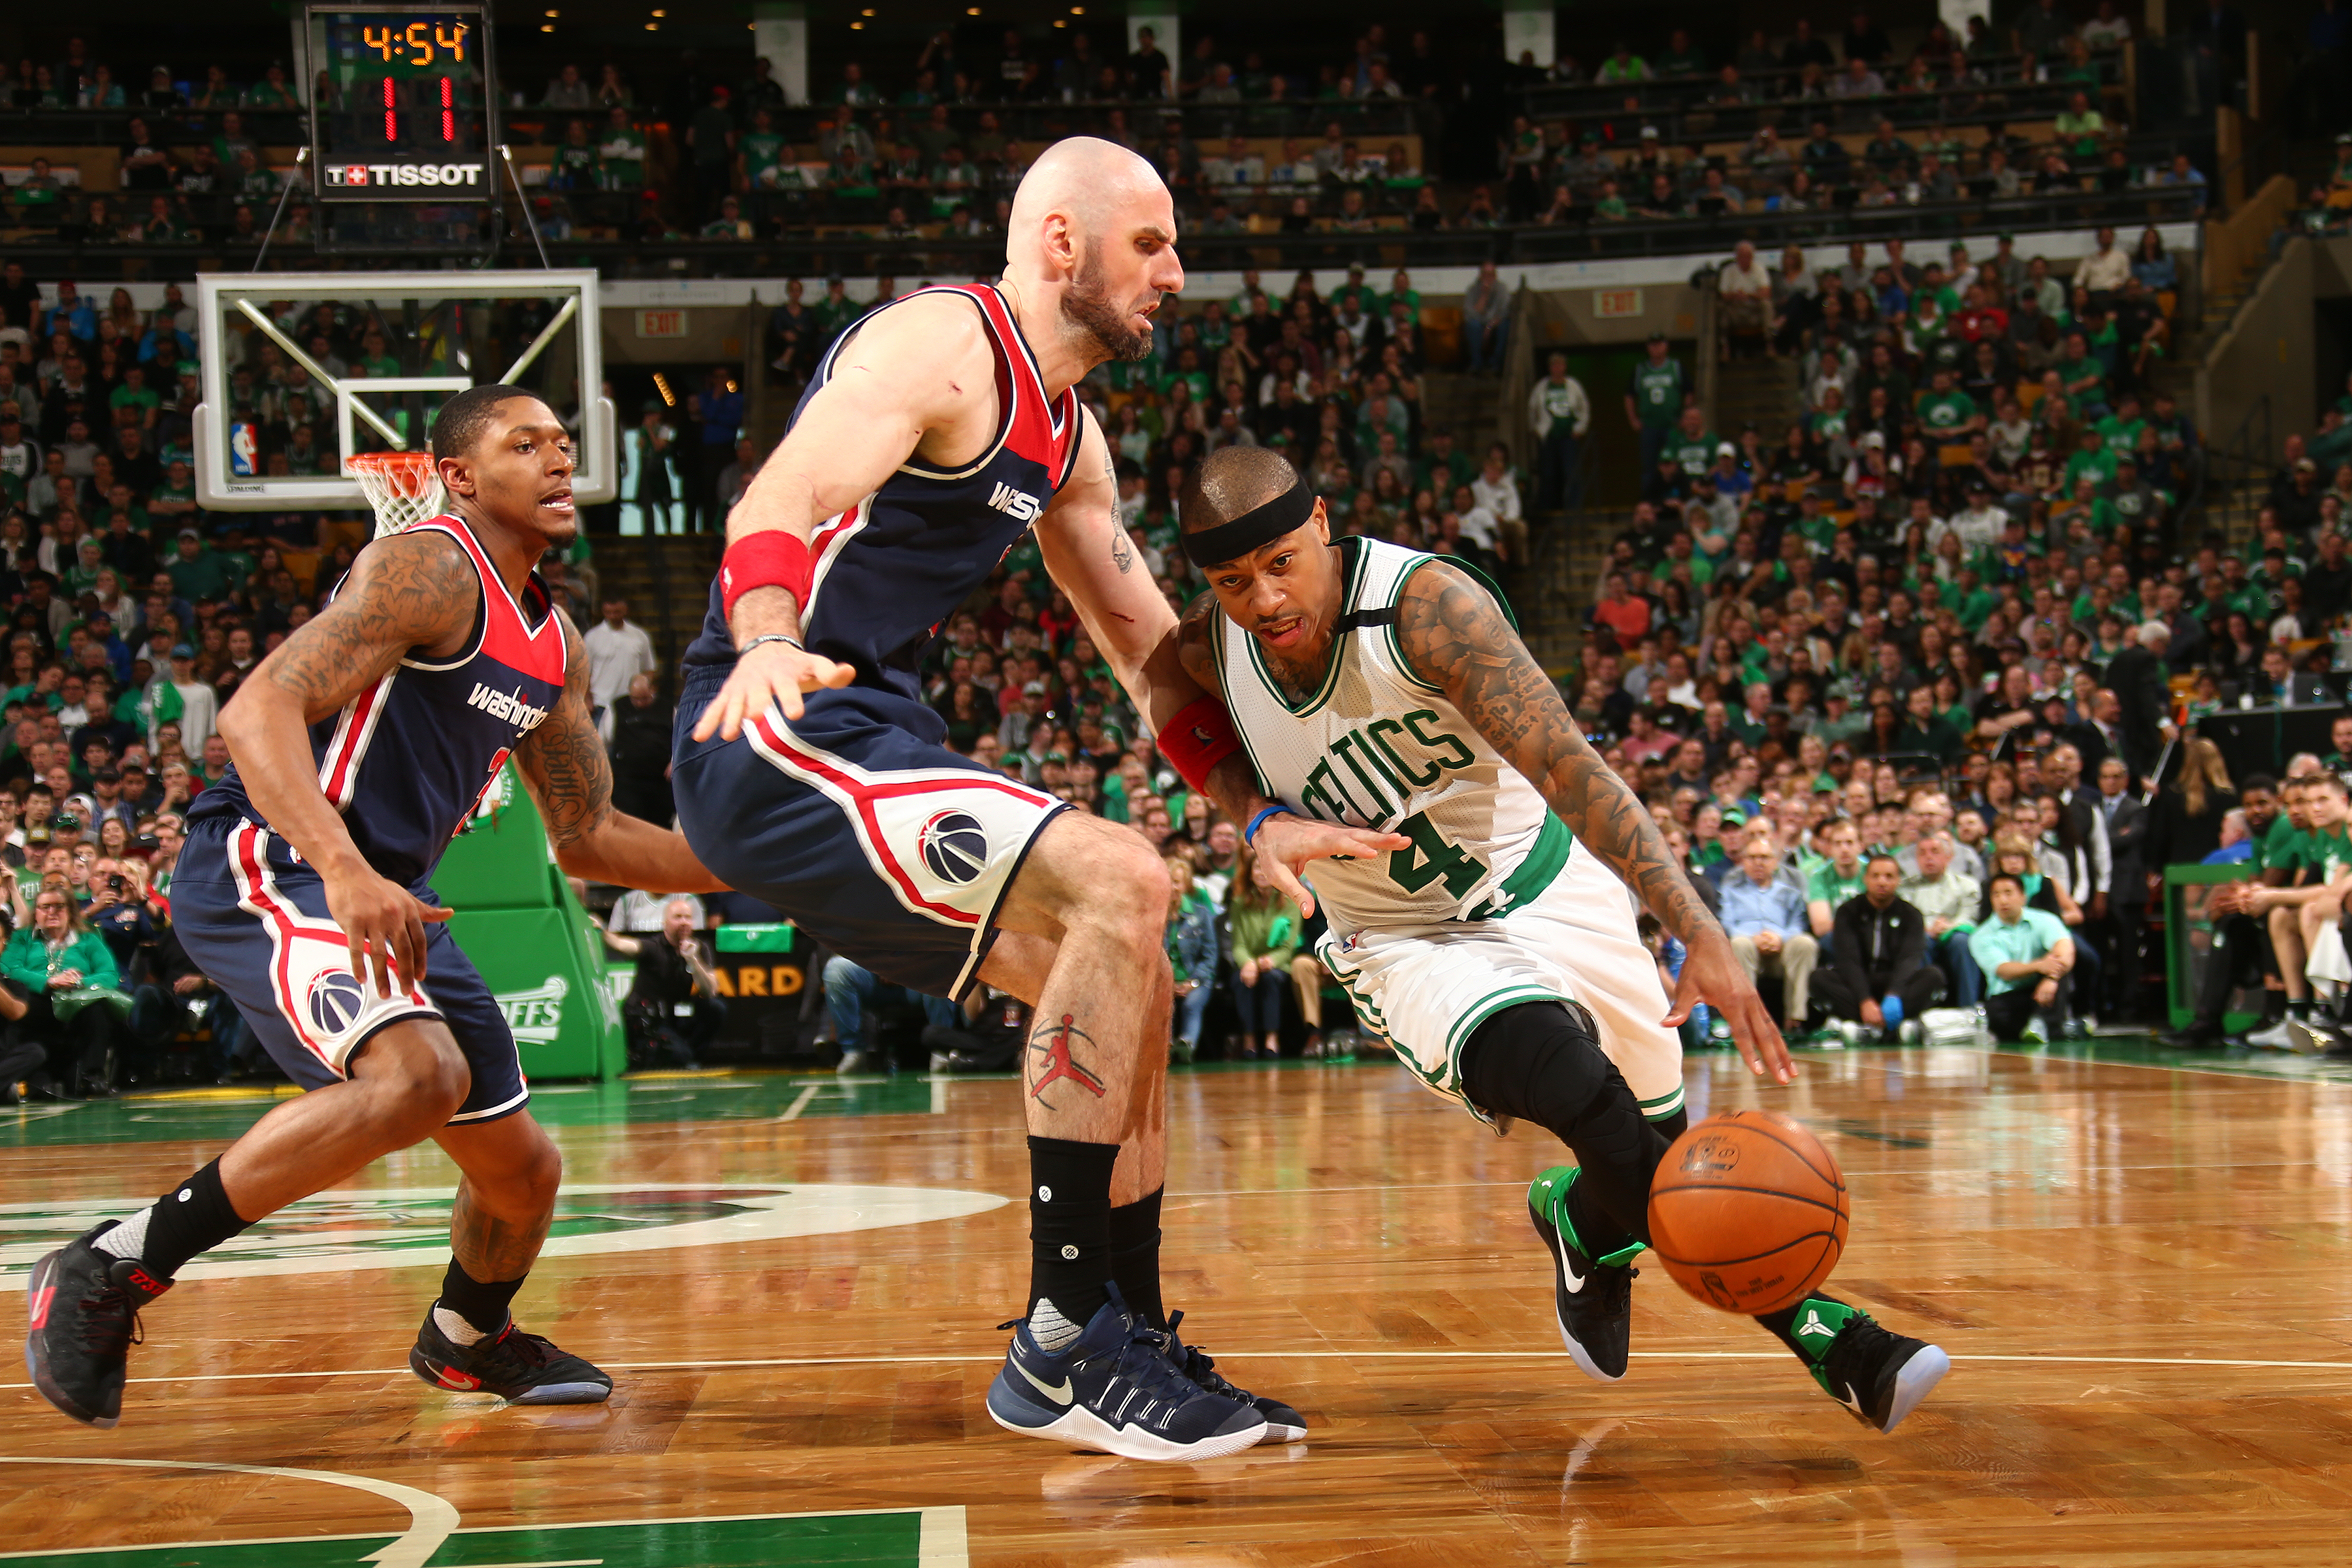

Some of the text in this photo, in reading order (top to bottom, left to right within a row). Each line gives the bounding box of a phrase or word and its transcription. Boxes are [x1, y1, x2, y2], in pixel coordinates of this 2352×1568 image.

[363, 22, 465, 66] 4:54
[383, 76, 455, 142] 11
[368, 164, 484, 186] TISSOT
[644, 312, 679, 335] EXIT
[1388, 810, 1488, 902] 4
